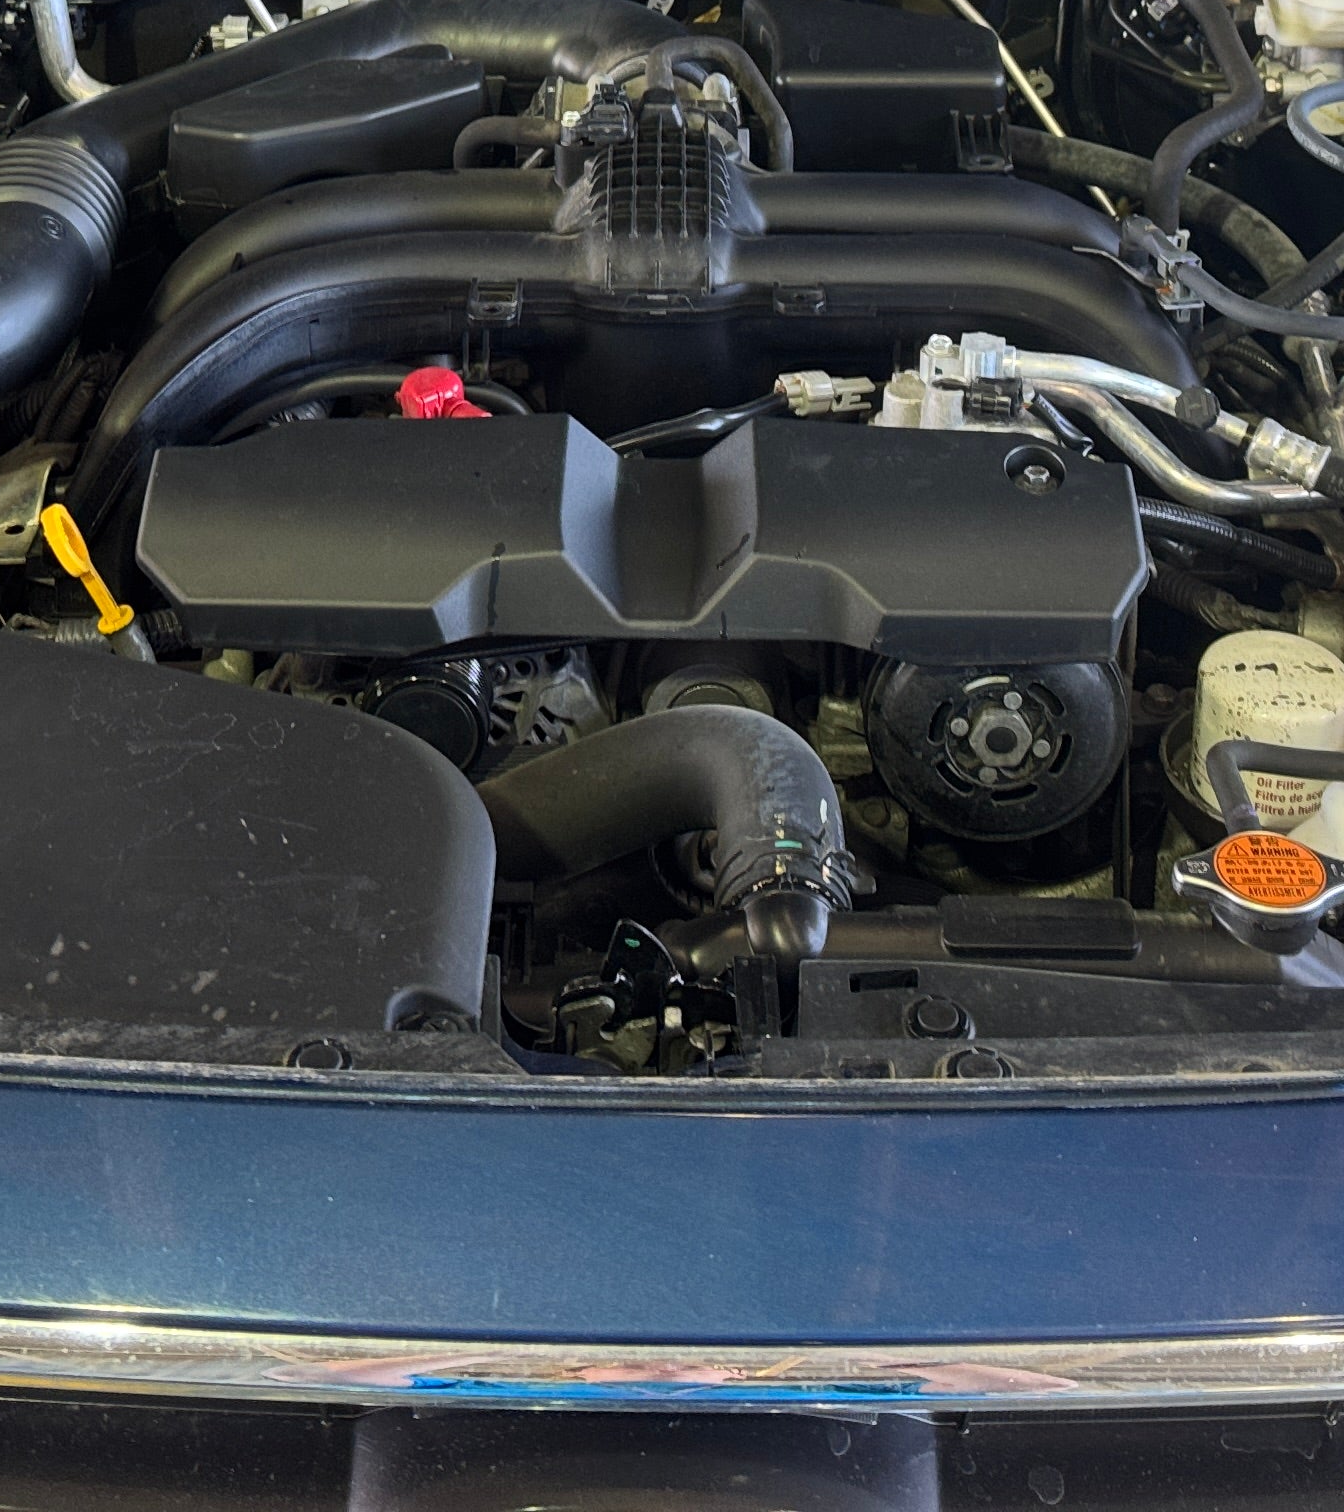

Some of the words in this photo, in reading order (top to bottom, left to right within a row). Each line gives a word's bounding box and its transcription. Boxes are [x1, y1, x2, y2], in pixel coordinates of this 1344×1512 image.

[1257, 777, 1272, 788] Oil
[1276, 780, 1305, 790] Filter
[1256, 790, 1285, 803] Filtro
[1290, 793, 1303, 803] de
[1250, 848, 1300, 857] WARNING
[1275, 868, 1296, 876] WHEN
